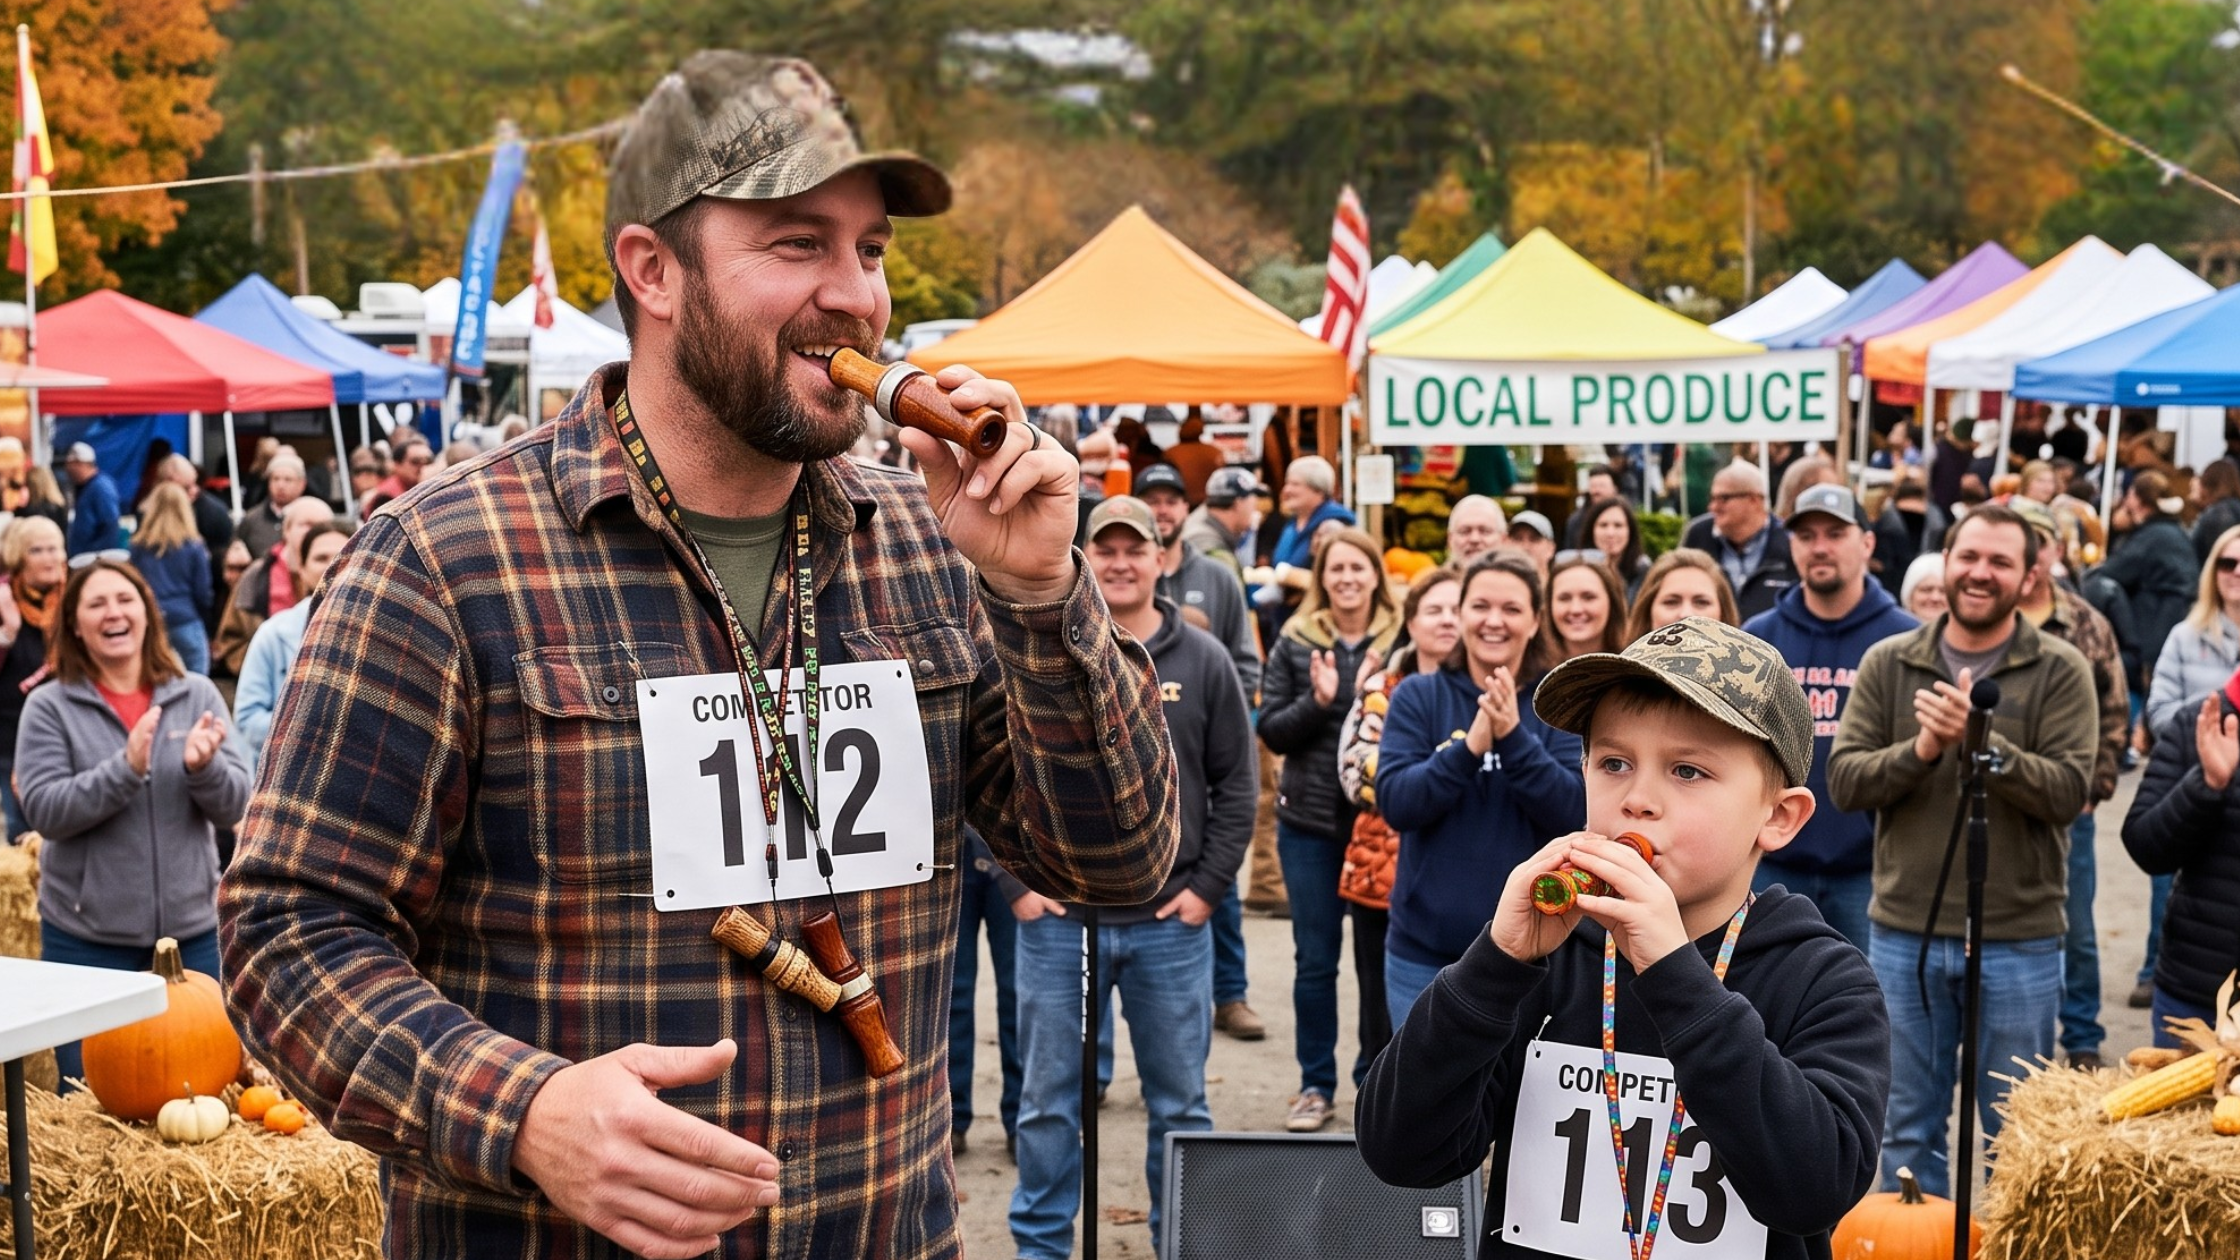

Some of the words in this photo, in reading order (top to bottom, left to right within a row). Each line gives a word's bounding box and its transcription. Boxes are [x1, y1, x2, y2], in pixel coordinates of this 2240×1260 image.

[1386, 375, 1551, 427] LOCAL
[1572, 371, 1826, 425] PRODUCE
[692, 683, 873, 722] COMETTOR
[698, 728, 886, 867] 112
[1554, 1107, 1727, 1244] 113
